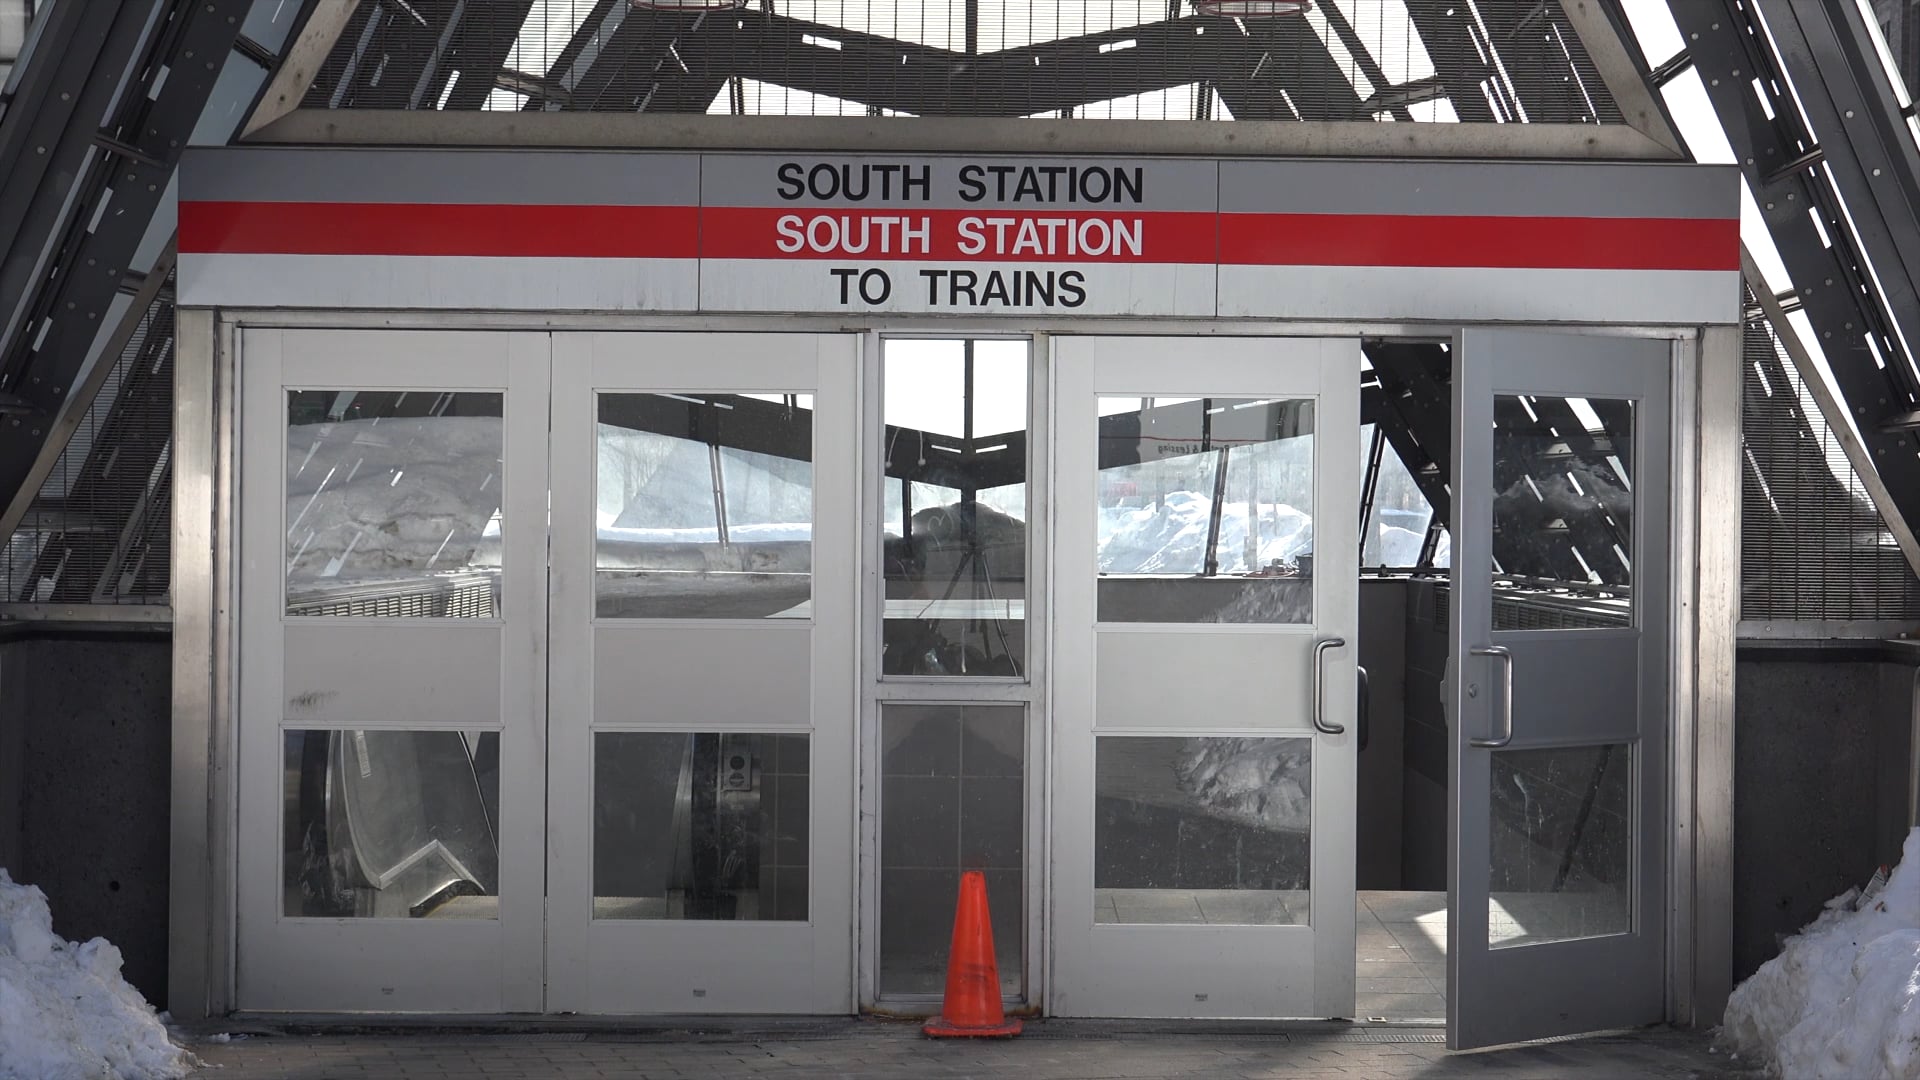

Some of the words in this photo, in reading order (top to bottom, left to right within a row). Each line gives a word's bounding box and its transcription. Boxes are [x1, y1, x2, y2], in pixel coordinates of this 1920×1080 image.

[777, 163, 930, 201] SOUTH
[959, 165, 1142, 203] STATION
[776, 215, 930, 253] SOUTH
[958, 217, 1142, 256] STATION
[831, 268, 892, 306] TO
[920, 270, 1086, 308] TRAINS
